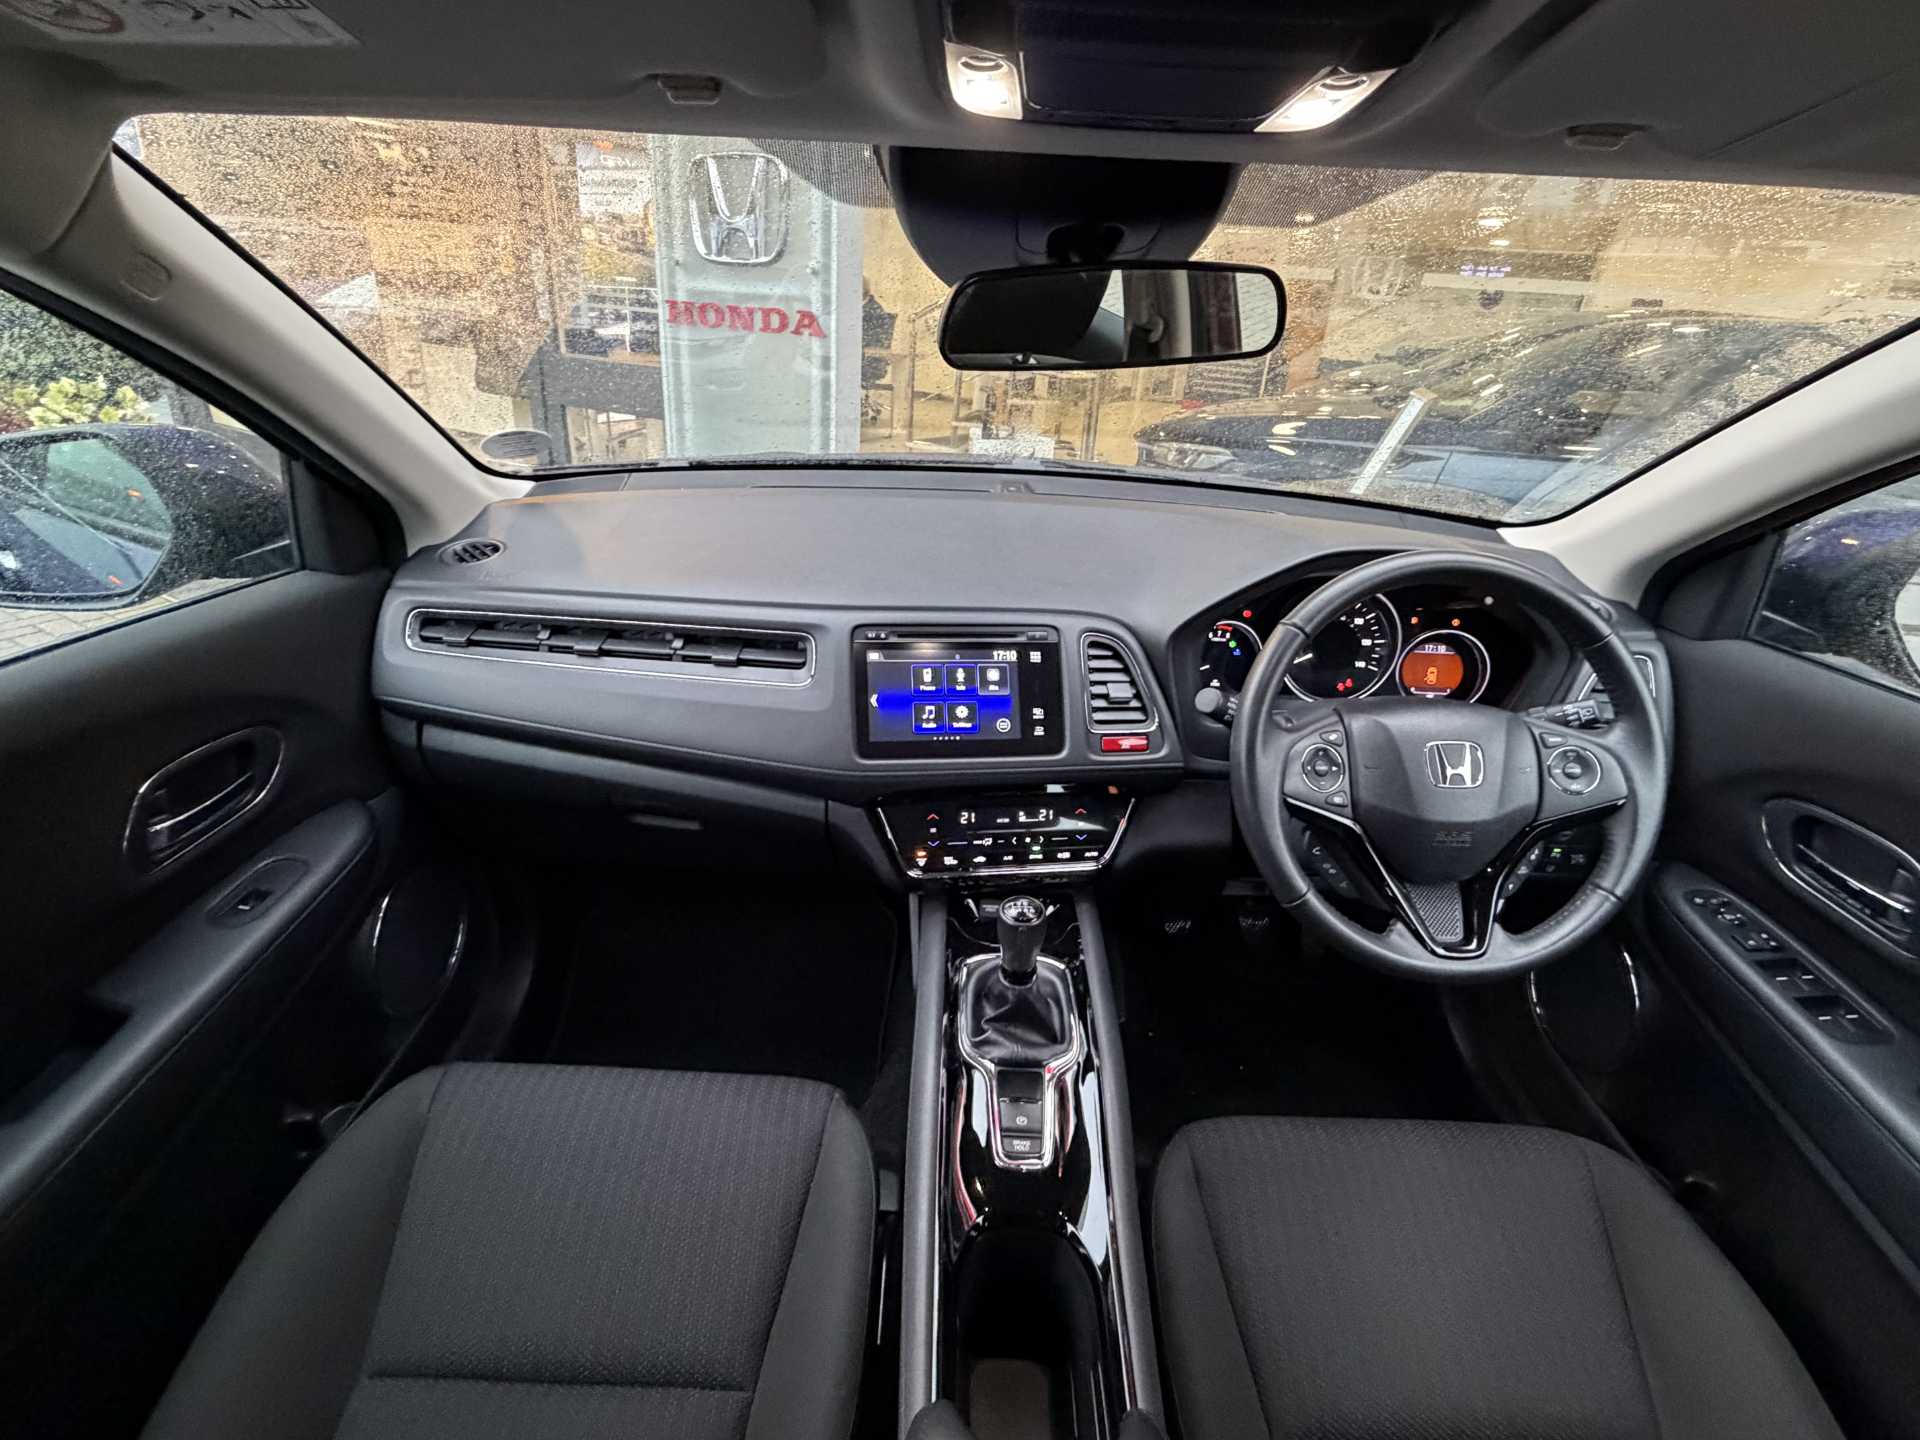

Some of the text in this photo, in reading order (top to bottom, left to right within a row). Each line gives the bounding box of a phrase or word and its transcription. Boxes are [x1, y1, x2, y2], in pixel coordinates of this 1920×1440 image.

[664, 299, 827, 338] HONDA
[1424, 644, 1447, 652] 17:10
[992, 650, 1018, 661] 17:10
[960, 812, 976, 824] 21
[1038, 808, 1054, 821] 21
